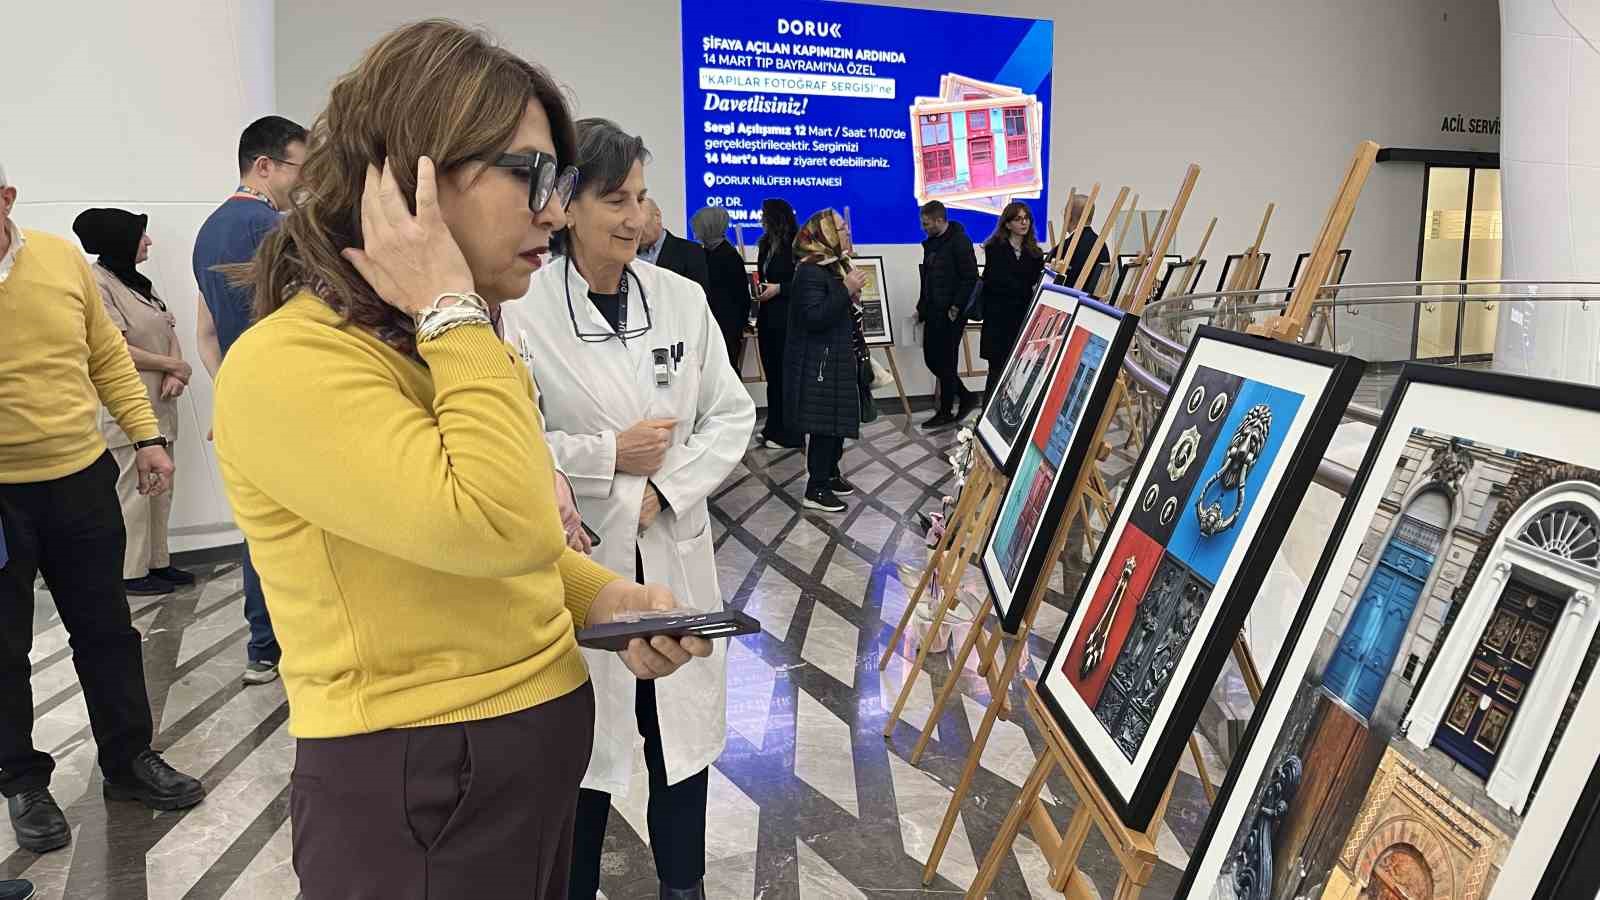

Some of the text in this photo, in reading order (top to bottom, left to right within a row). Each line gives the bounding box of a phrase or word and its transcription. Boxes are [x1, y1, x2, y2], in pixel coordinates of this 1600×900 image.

[702, 34, 906, 64] ŞİFAYA AÇILAN KAPIMIZIN ARDINDA
[703, 52, 876, 76] 14 MART TIP BAYRAMI'NA ÖZEL
[703, 92, 809, 116] Davetlisiniz!
[703, 121, 735, 135] Sergi
[794, 124, 807, 136] 12
[808, 125, 833, 138] Mart
[834, 125, 840, 138] /
[867, 127, 907, 140] 11.00'de
[1441, 113, 1466, 133] ACİL
[704, 138, 858, 153] gerçekleştirilecektir. Sergimizi
[704, 152, 891, 169] 14 Mart'a kadar ziyaret edebilirsiniz.
[716, 175, 842, 187] DORUK NİLÜFER HASTANESİ
[706, 196, 743, 207] OP. DR.
